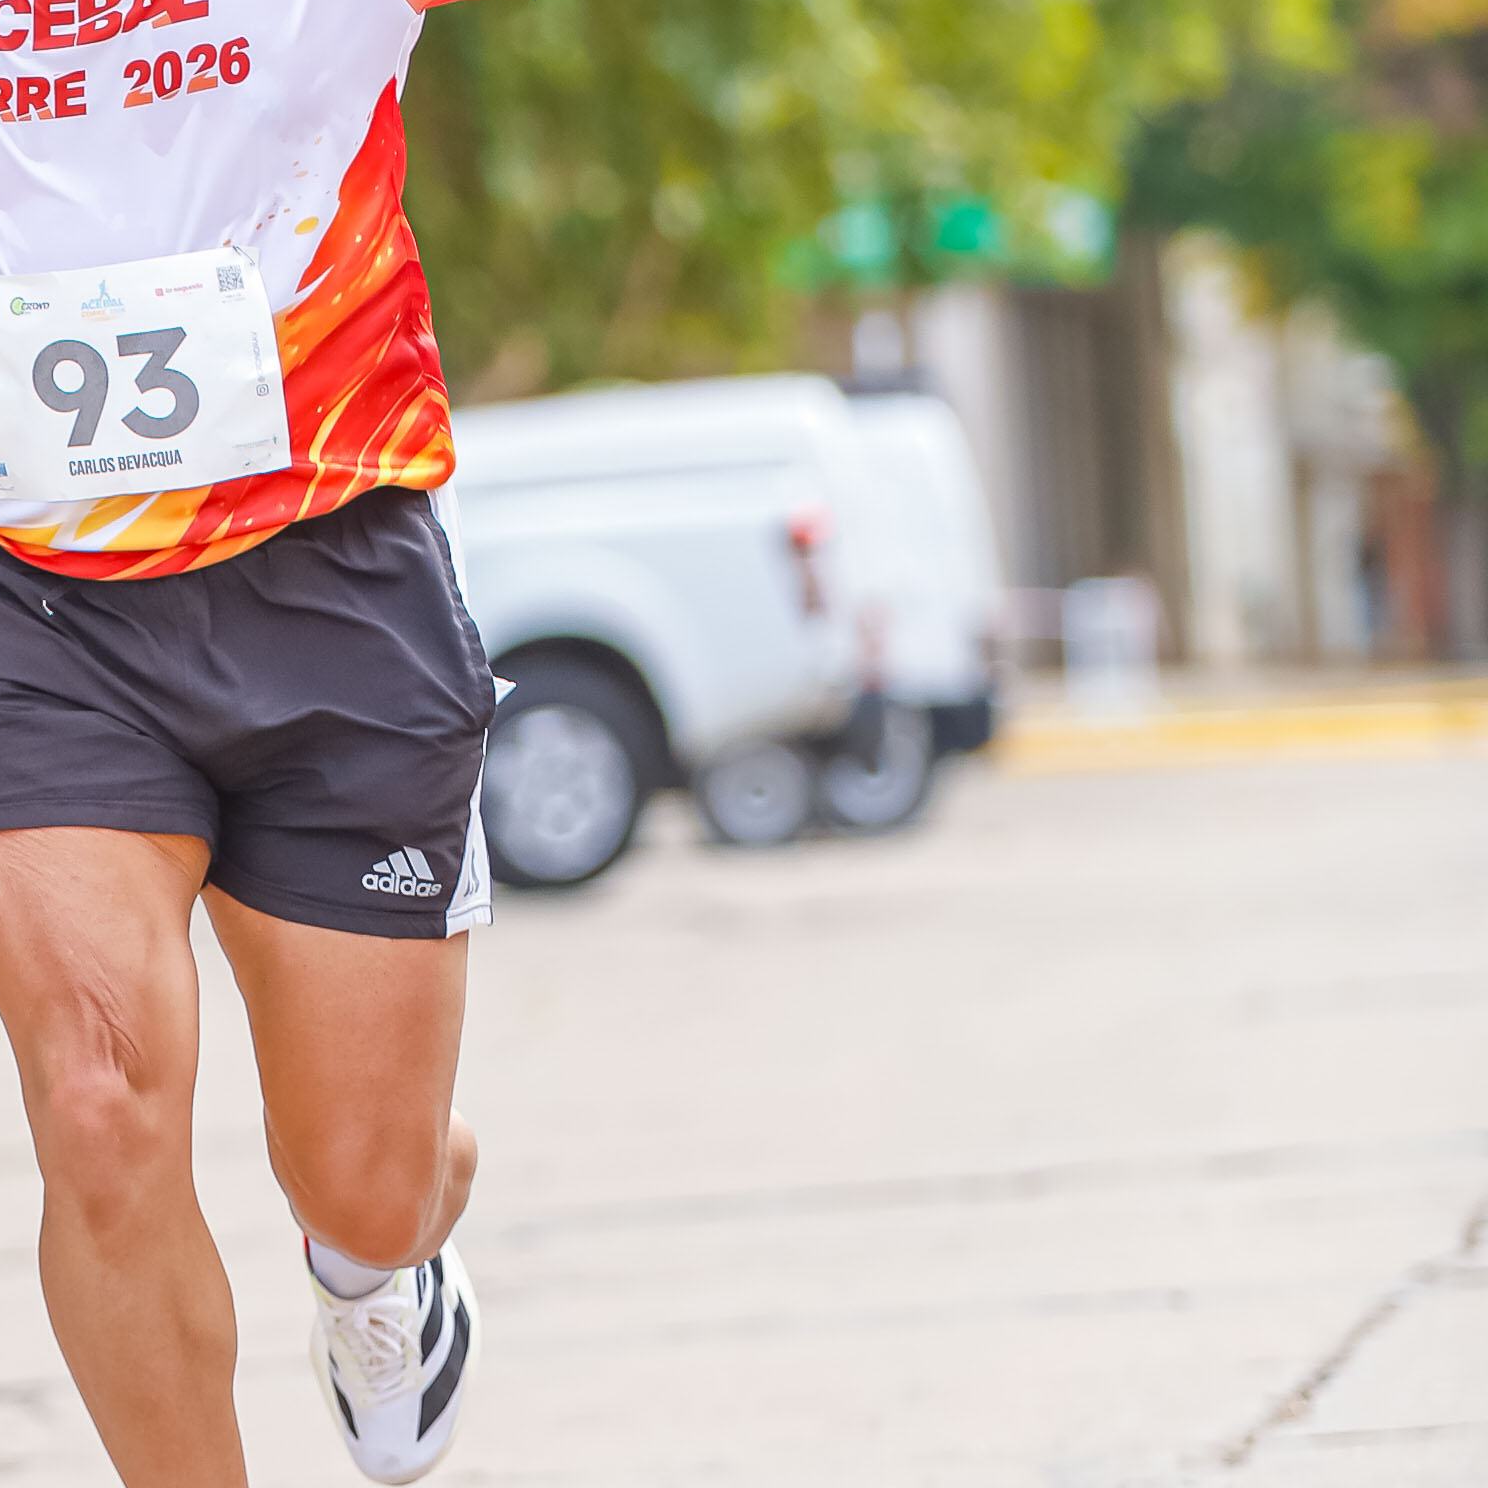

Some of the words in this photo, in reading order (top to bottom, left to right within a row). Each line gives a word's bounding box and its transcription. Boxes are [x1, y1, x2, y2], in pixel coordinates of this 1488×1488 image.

[123, 36, 250, 108] 2026
[32, 326, 200, 448] 93
[69, 456, 115, 476] CARLOS
[118, 449, 183, 472] BEVACQUA
[362, 873, 442, 898] adidas
